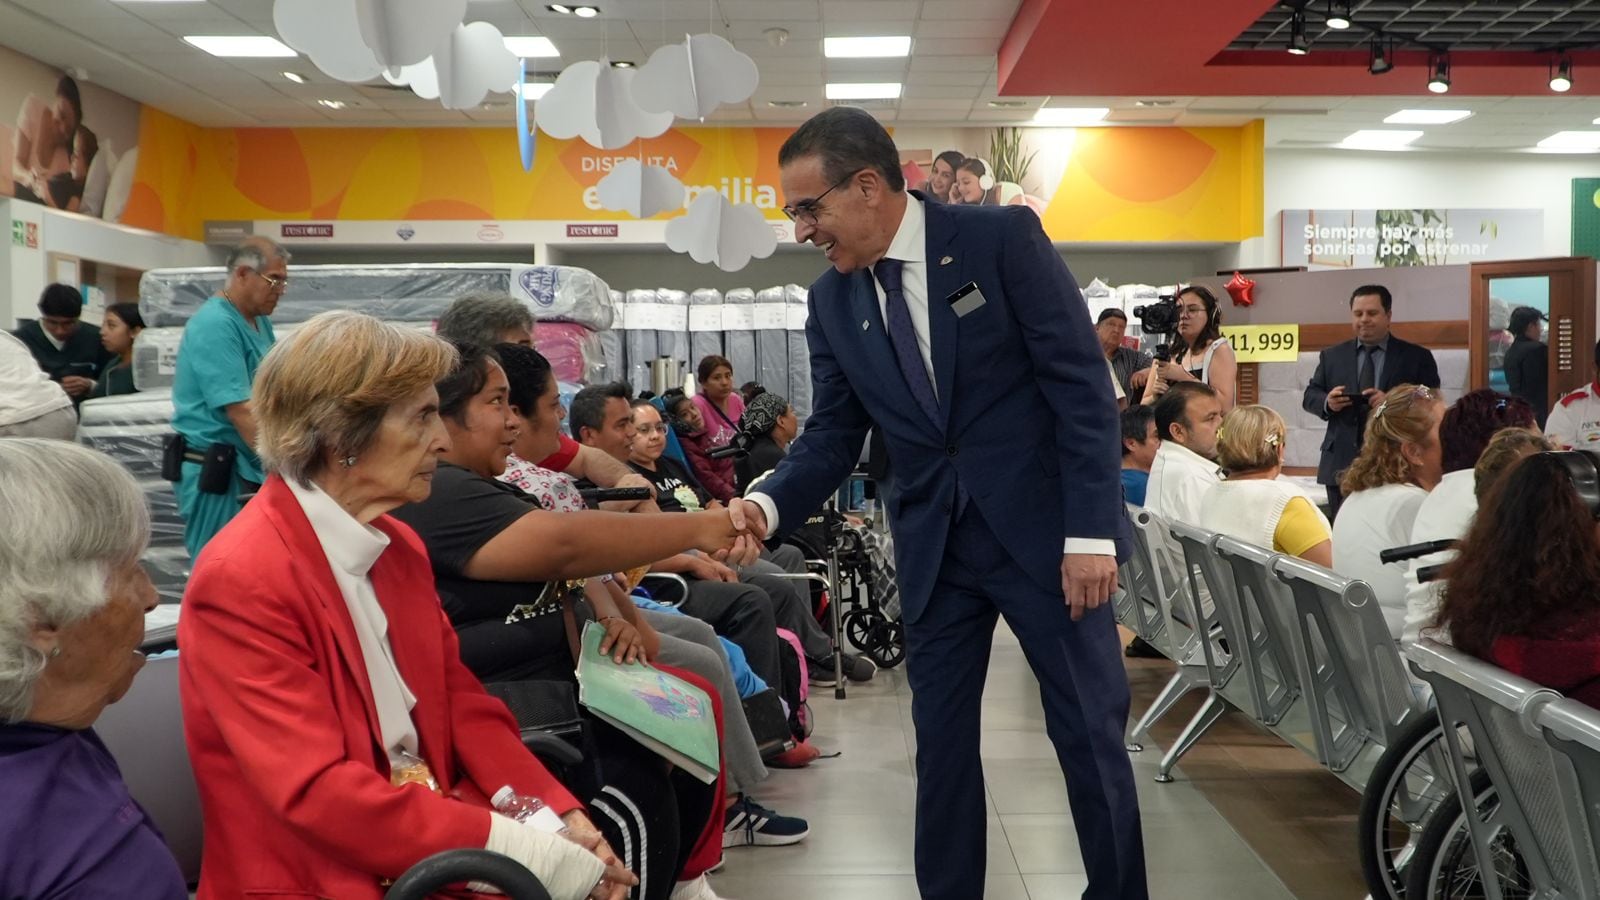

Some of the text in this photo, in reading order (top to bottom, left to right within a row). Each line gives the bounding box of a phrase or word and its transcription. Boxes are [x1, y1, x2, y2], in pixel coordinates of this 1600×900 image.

[581, 156, 678, 172] DISTA
[1304, 223, 1454, 242] Siempre hay más
[1303, 240, 1489, 258] sonrisas por estrenar
